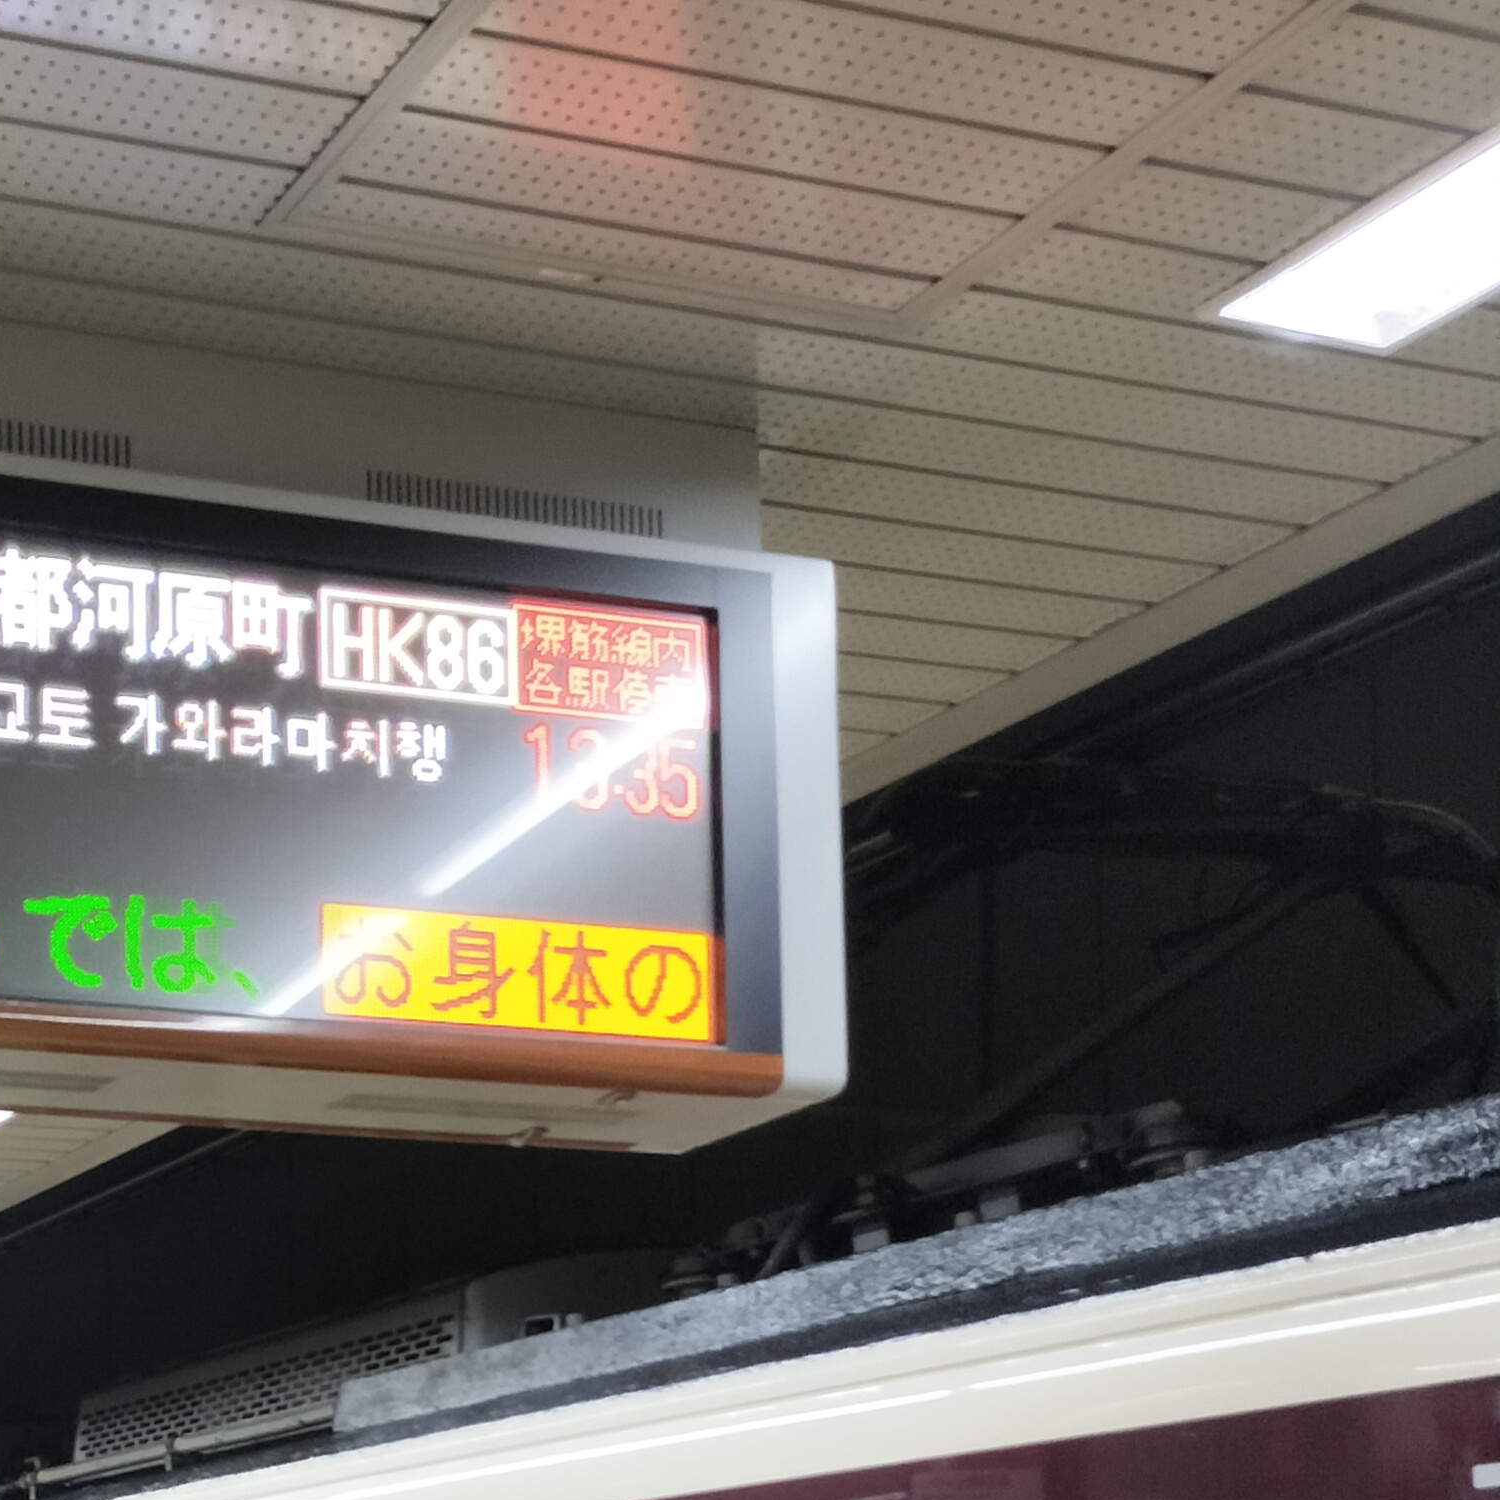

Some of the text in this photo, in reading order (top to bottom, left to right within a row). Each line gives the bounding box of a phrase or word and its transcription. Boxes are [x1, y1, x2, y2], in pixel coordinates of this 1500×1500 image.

[332, 602, 507, 696] HK86
[114, 691, 451, 783] 가와라마치행
[333, 914, 702, 1026] お身体の
